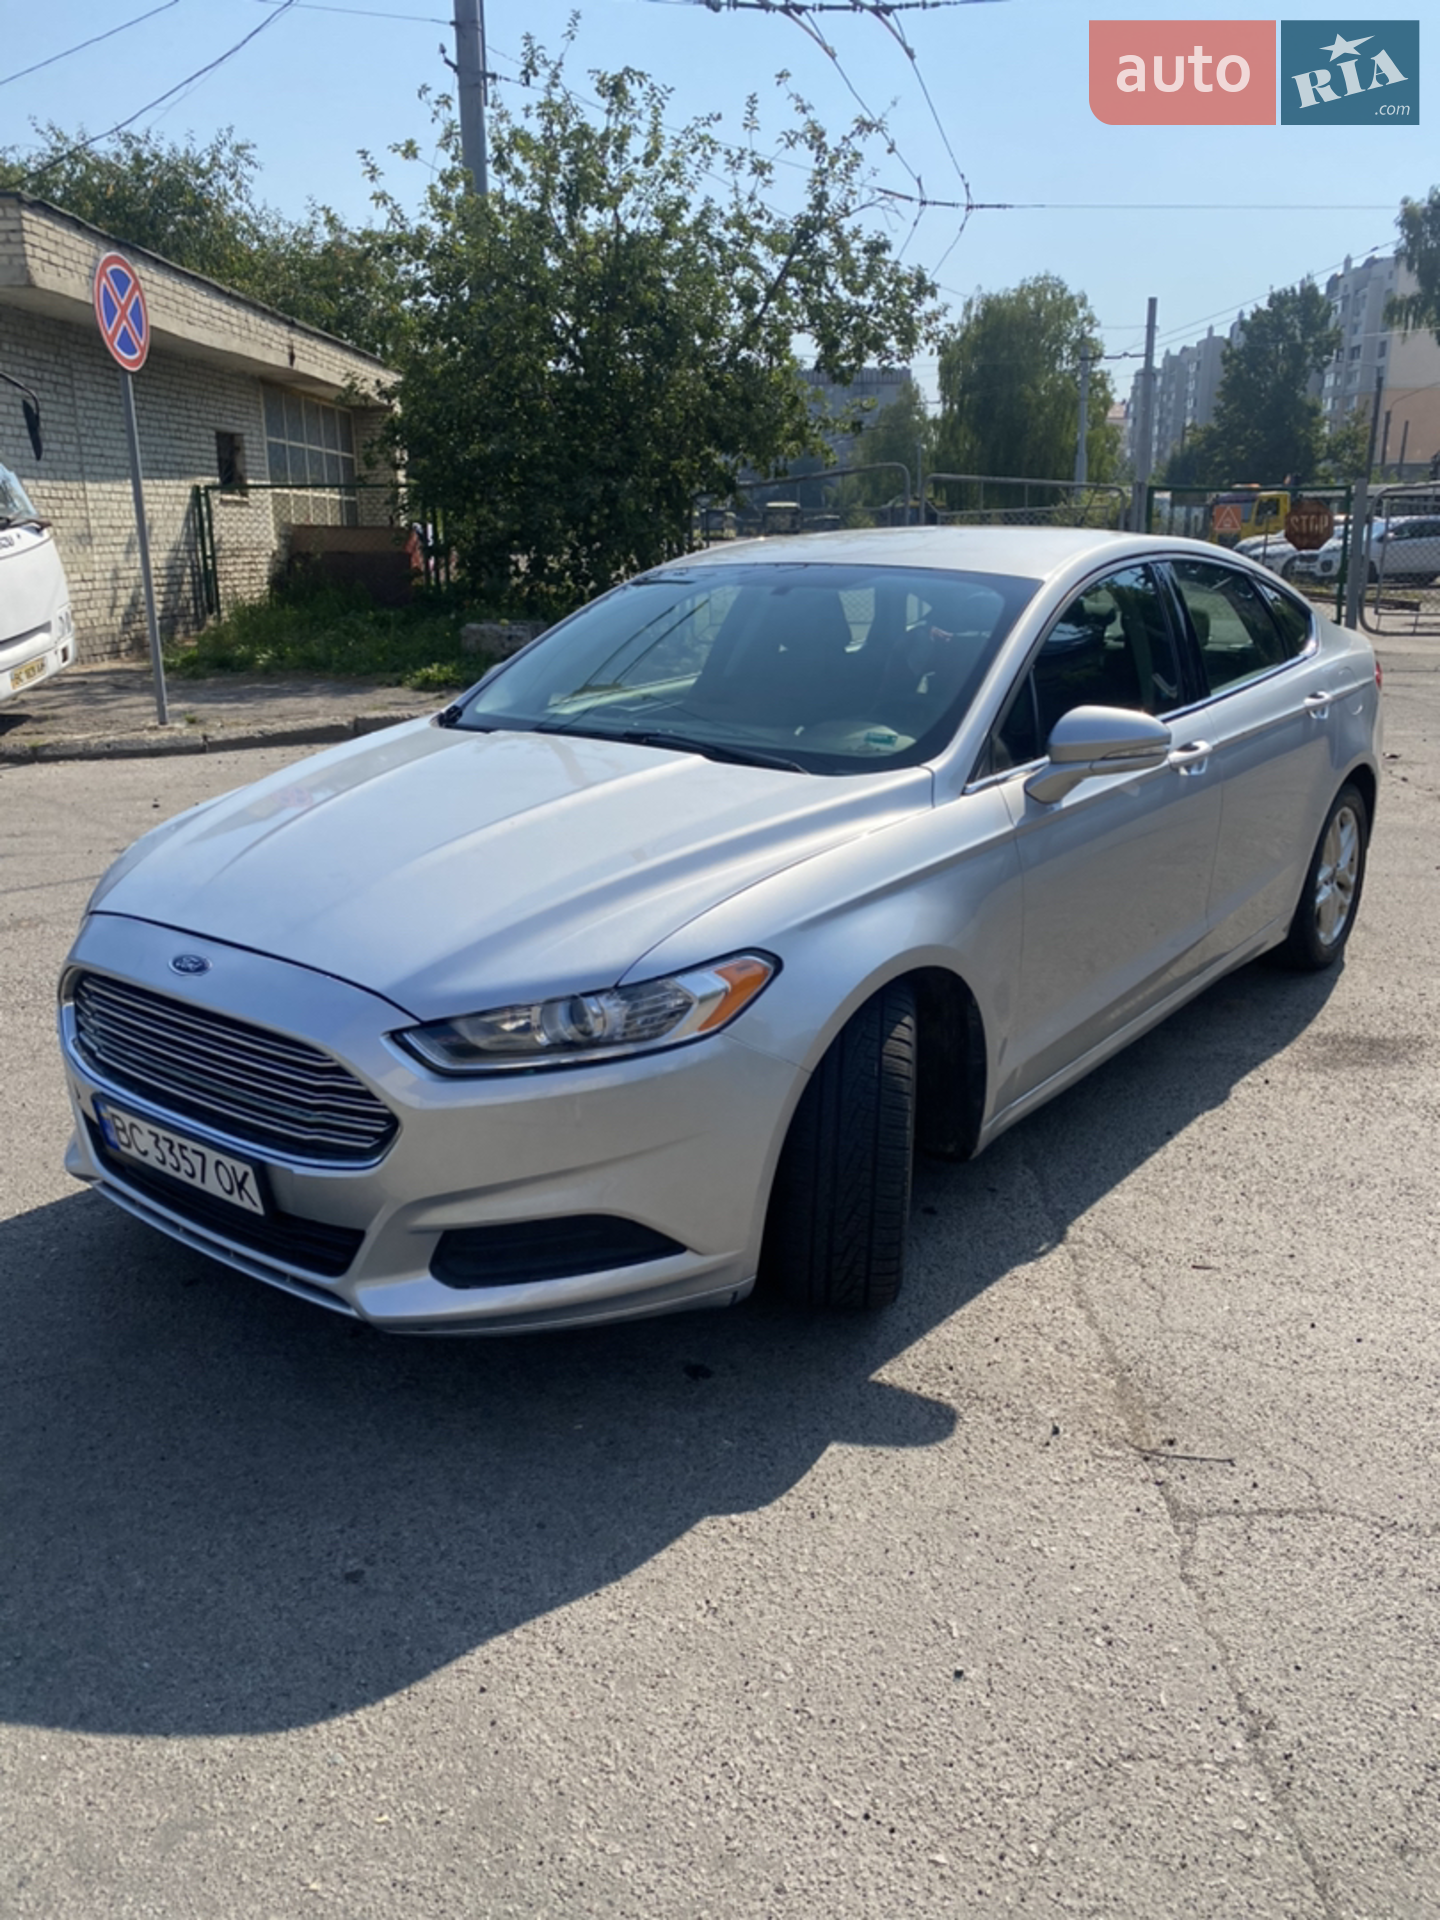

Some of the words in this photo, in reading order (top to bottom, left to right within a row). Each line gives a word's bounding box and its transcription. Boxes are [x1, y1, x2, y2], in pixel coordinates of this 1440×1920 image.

[1290, 514, 1330, 534] STOP
[111, 1112, 149, 1159] BC
[149, 1130, 206, 1184] 3357
[214, 1158, 258, 1208] OK
